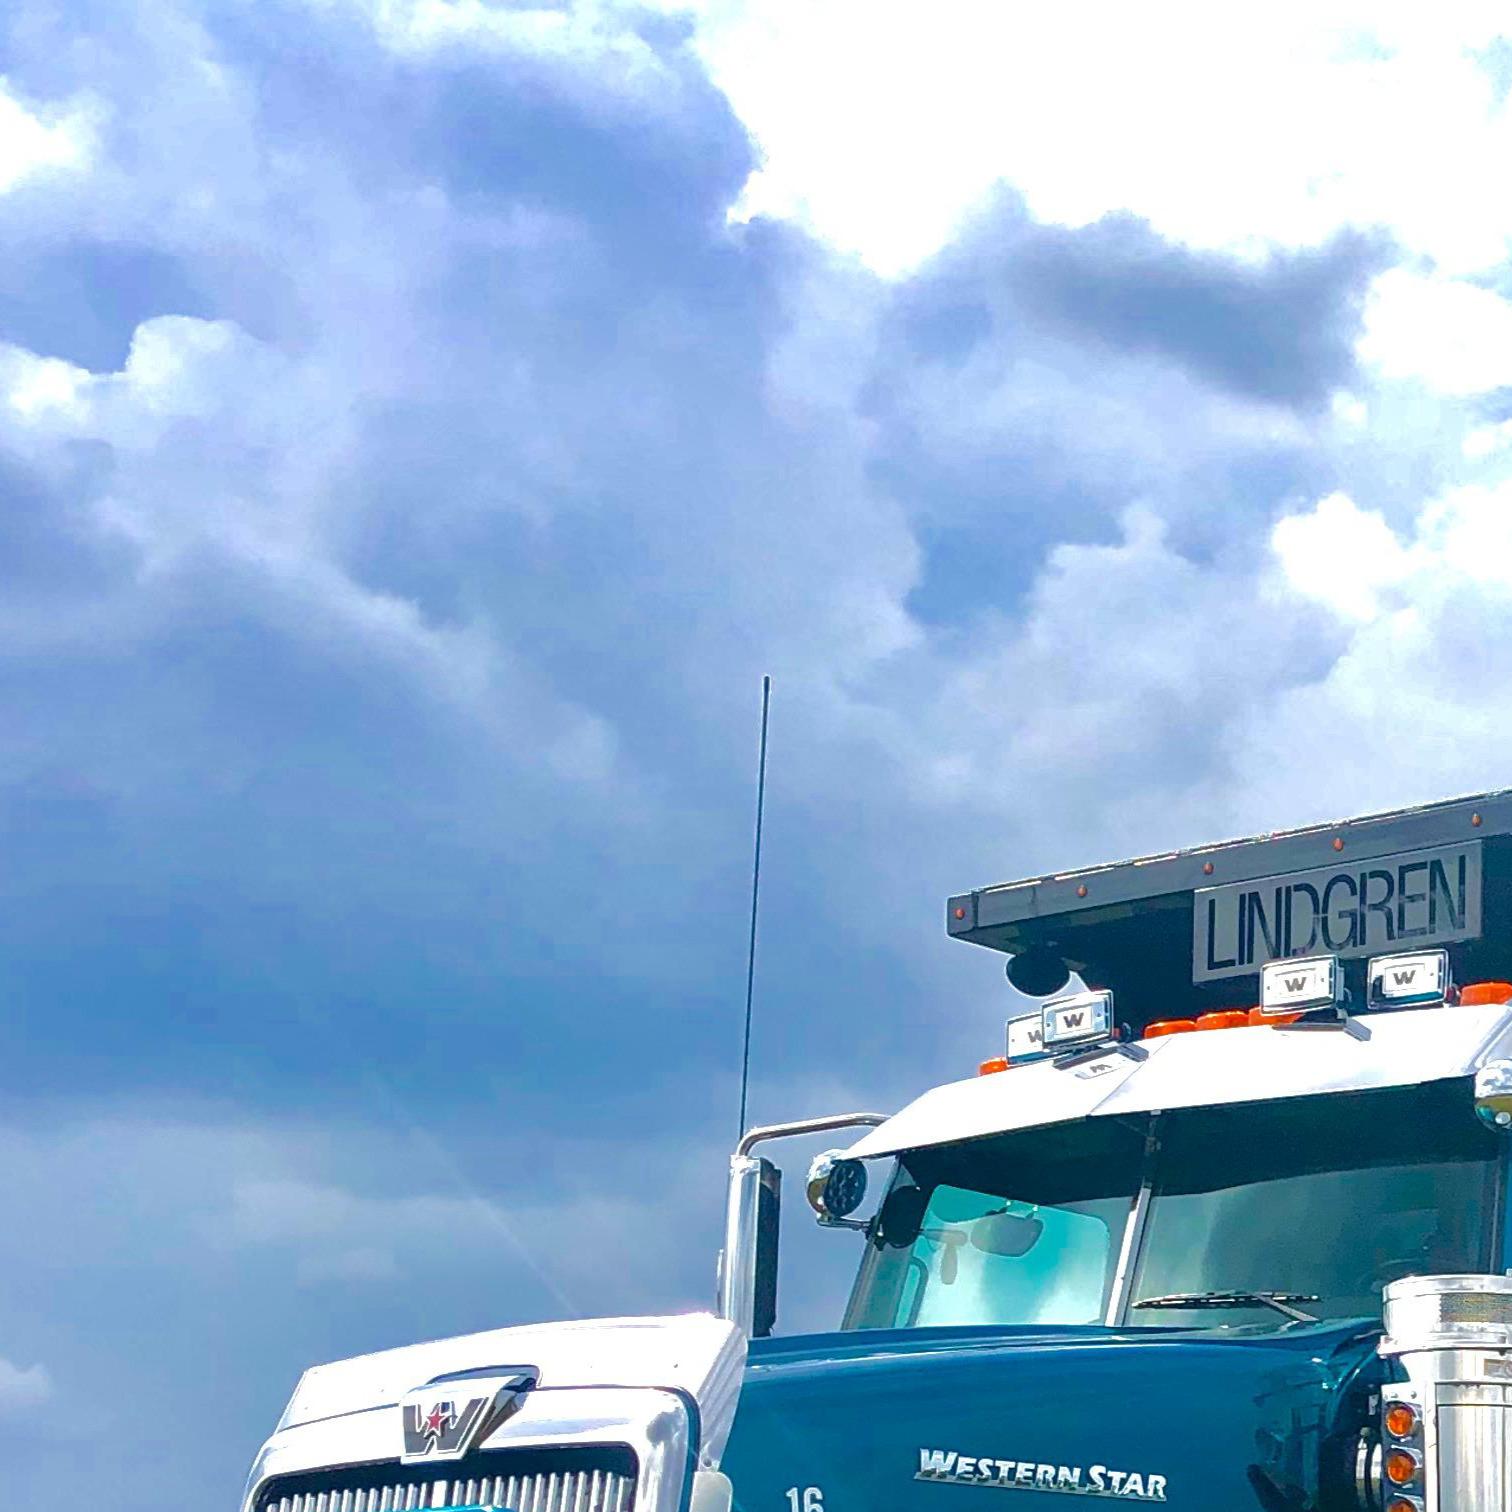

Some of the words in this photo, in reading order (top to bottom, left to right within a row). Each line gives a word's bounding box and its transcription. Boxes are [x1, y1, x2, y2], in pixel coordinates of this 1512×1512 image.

[1207, 854, 1467, 970] LINDGREN
[1284, 976, 1307, 993] W
[1392, 969, 1417, 986] W
[1063, 1012, 1084, 1029] W
[918, 1447, 1082, 1491] WESTERN
[1086, 1464, 1168, 1499] STAR
